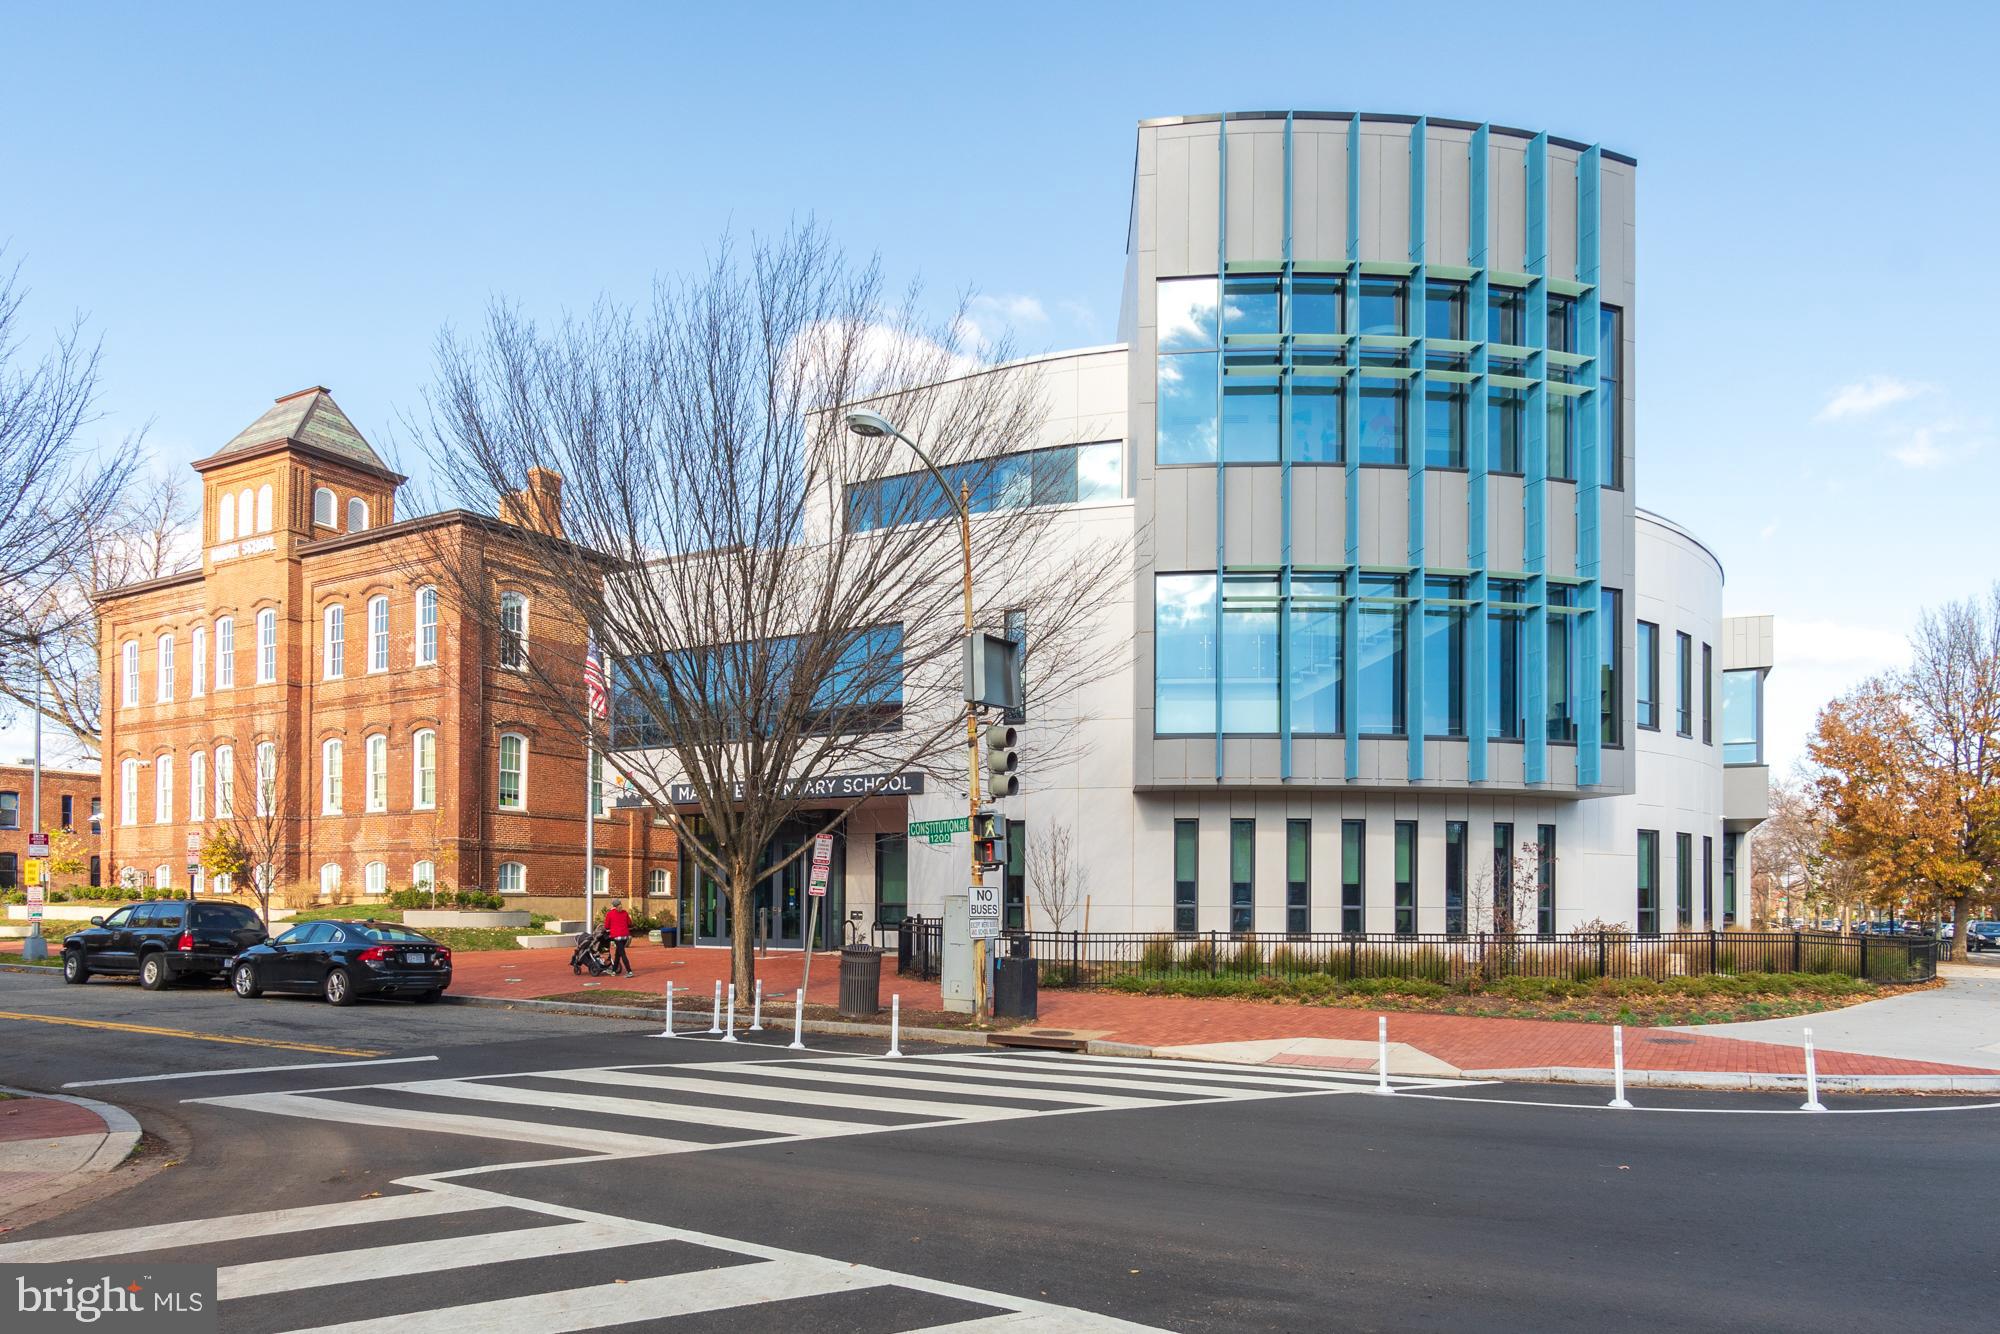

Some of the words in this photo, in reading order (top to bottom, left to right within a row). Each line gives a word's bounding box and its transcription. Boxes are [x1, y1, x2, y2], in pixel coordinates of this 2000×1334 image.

[843, 775, 912, 793] SCHOOL
[910, 820, 959, 835] CONSTITUTION
[930, 833, 950, 843] 1200
[976, 890, 993, 901] NO
[971, 904, 998, 915] BUSES
